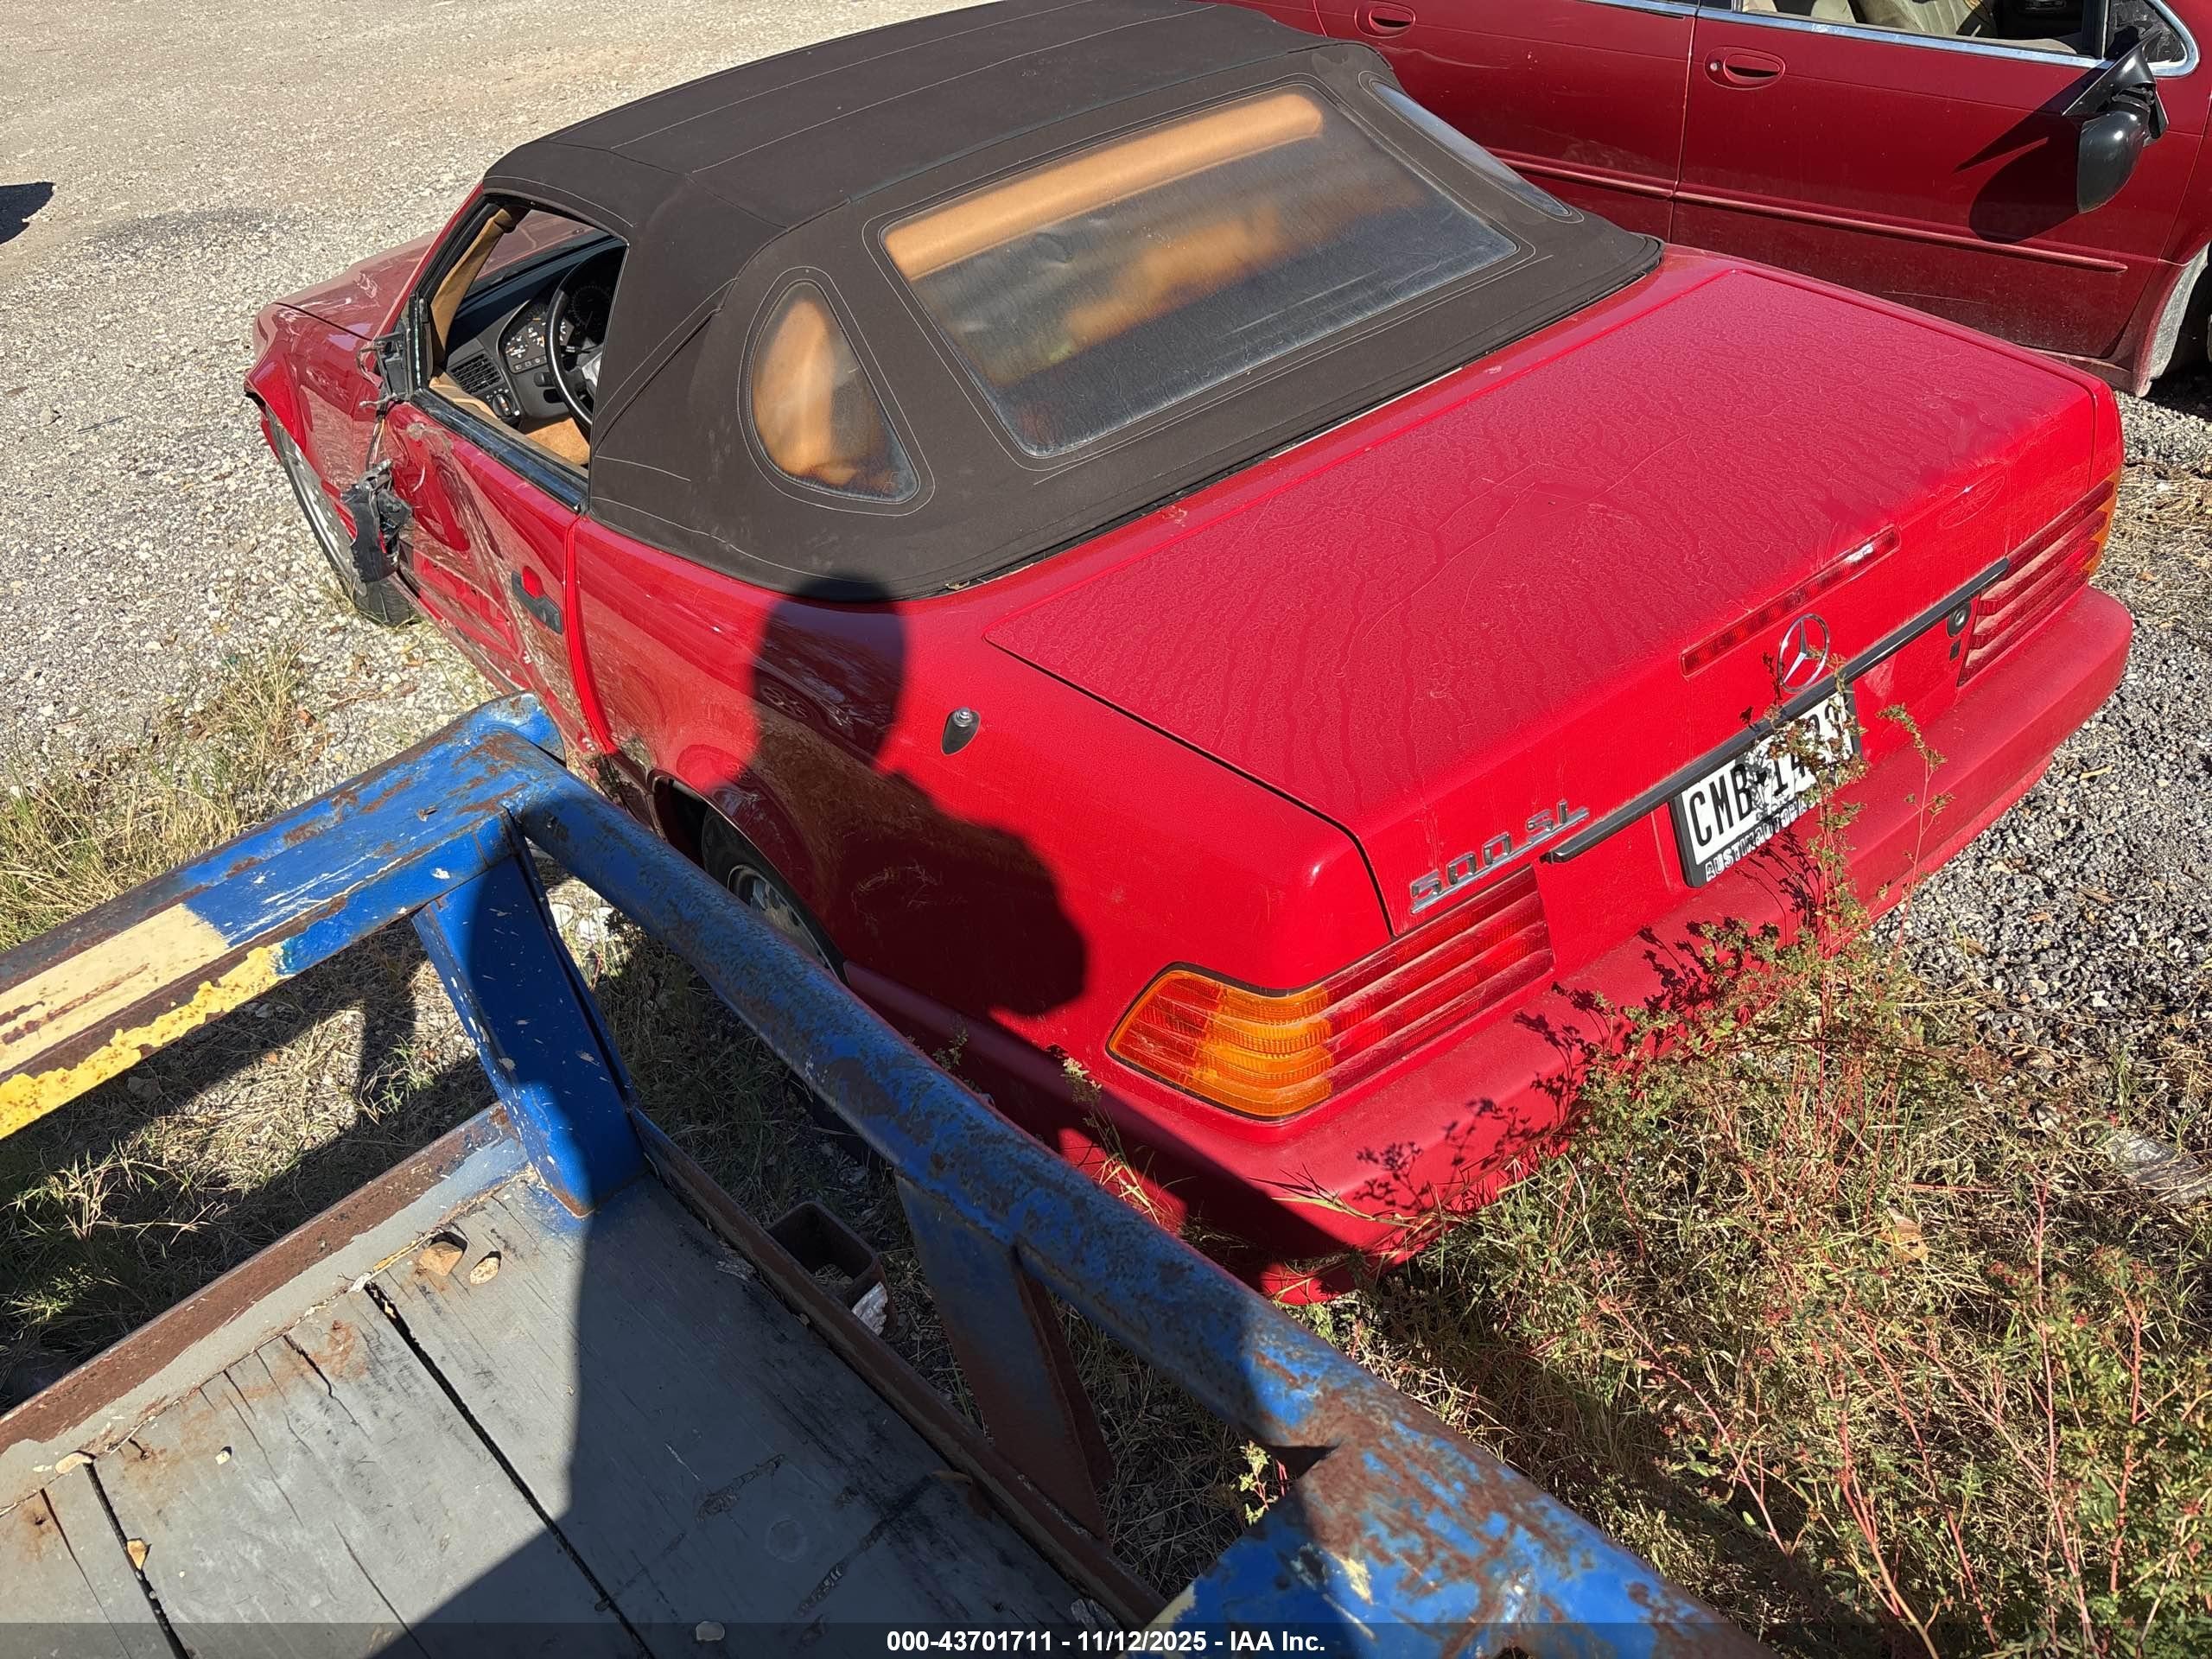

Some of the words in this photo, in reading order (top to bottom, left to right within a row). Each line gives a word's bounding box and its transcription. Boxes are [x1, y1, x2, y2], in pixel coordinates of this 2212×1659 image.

[1410, 831, 1512, 913] 500
[1526, 798, 1589, 845] SL
[1688, 763, 1753, 848] CMB
